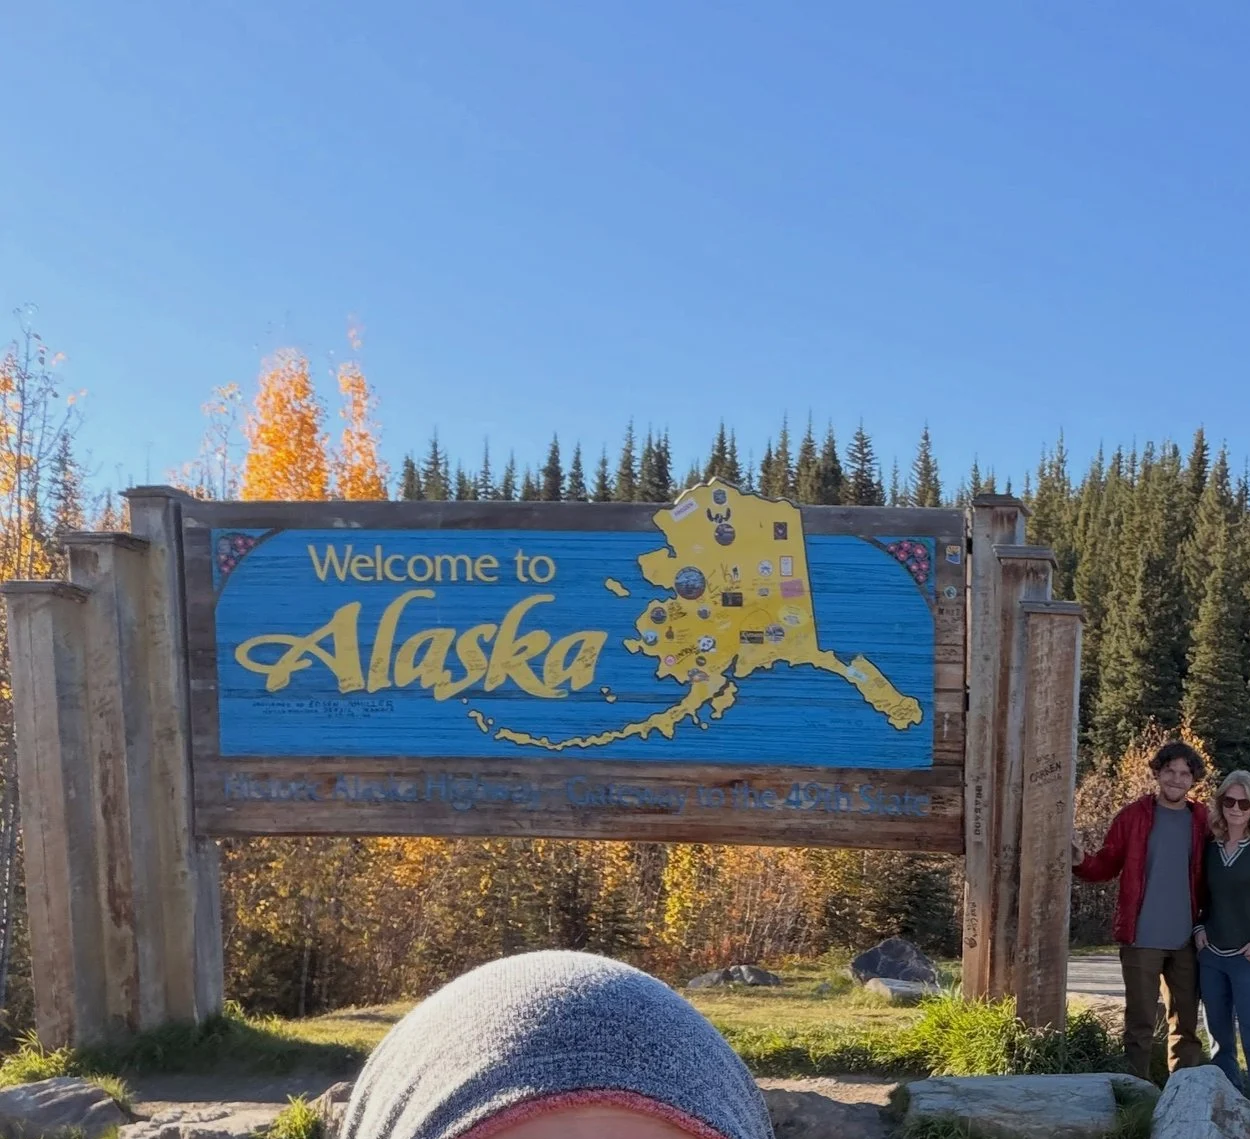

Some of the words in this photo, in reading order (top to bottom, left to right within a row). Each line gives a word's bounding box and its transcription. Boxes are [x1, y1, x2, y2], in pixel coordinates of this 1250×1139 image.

[307, 544, 499, 582] Welcome
[514, 548, 556, 583] to
[234, 589, 608, 700] Alaska
[333, 772, 417, 802] Alaska
[566, 776, 688, 816] Gateway
[697, 784, 725, 810] to
[732, 782, 779, 811] the
[785, 782, 849, 814] 49th
[859, 784, 929, 817] State
